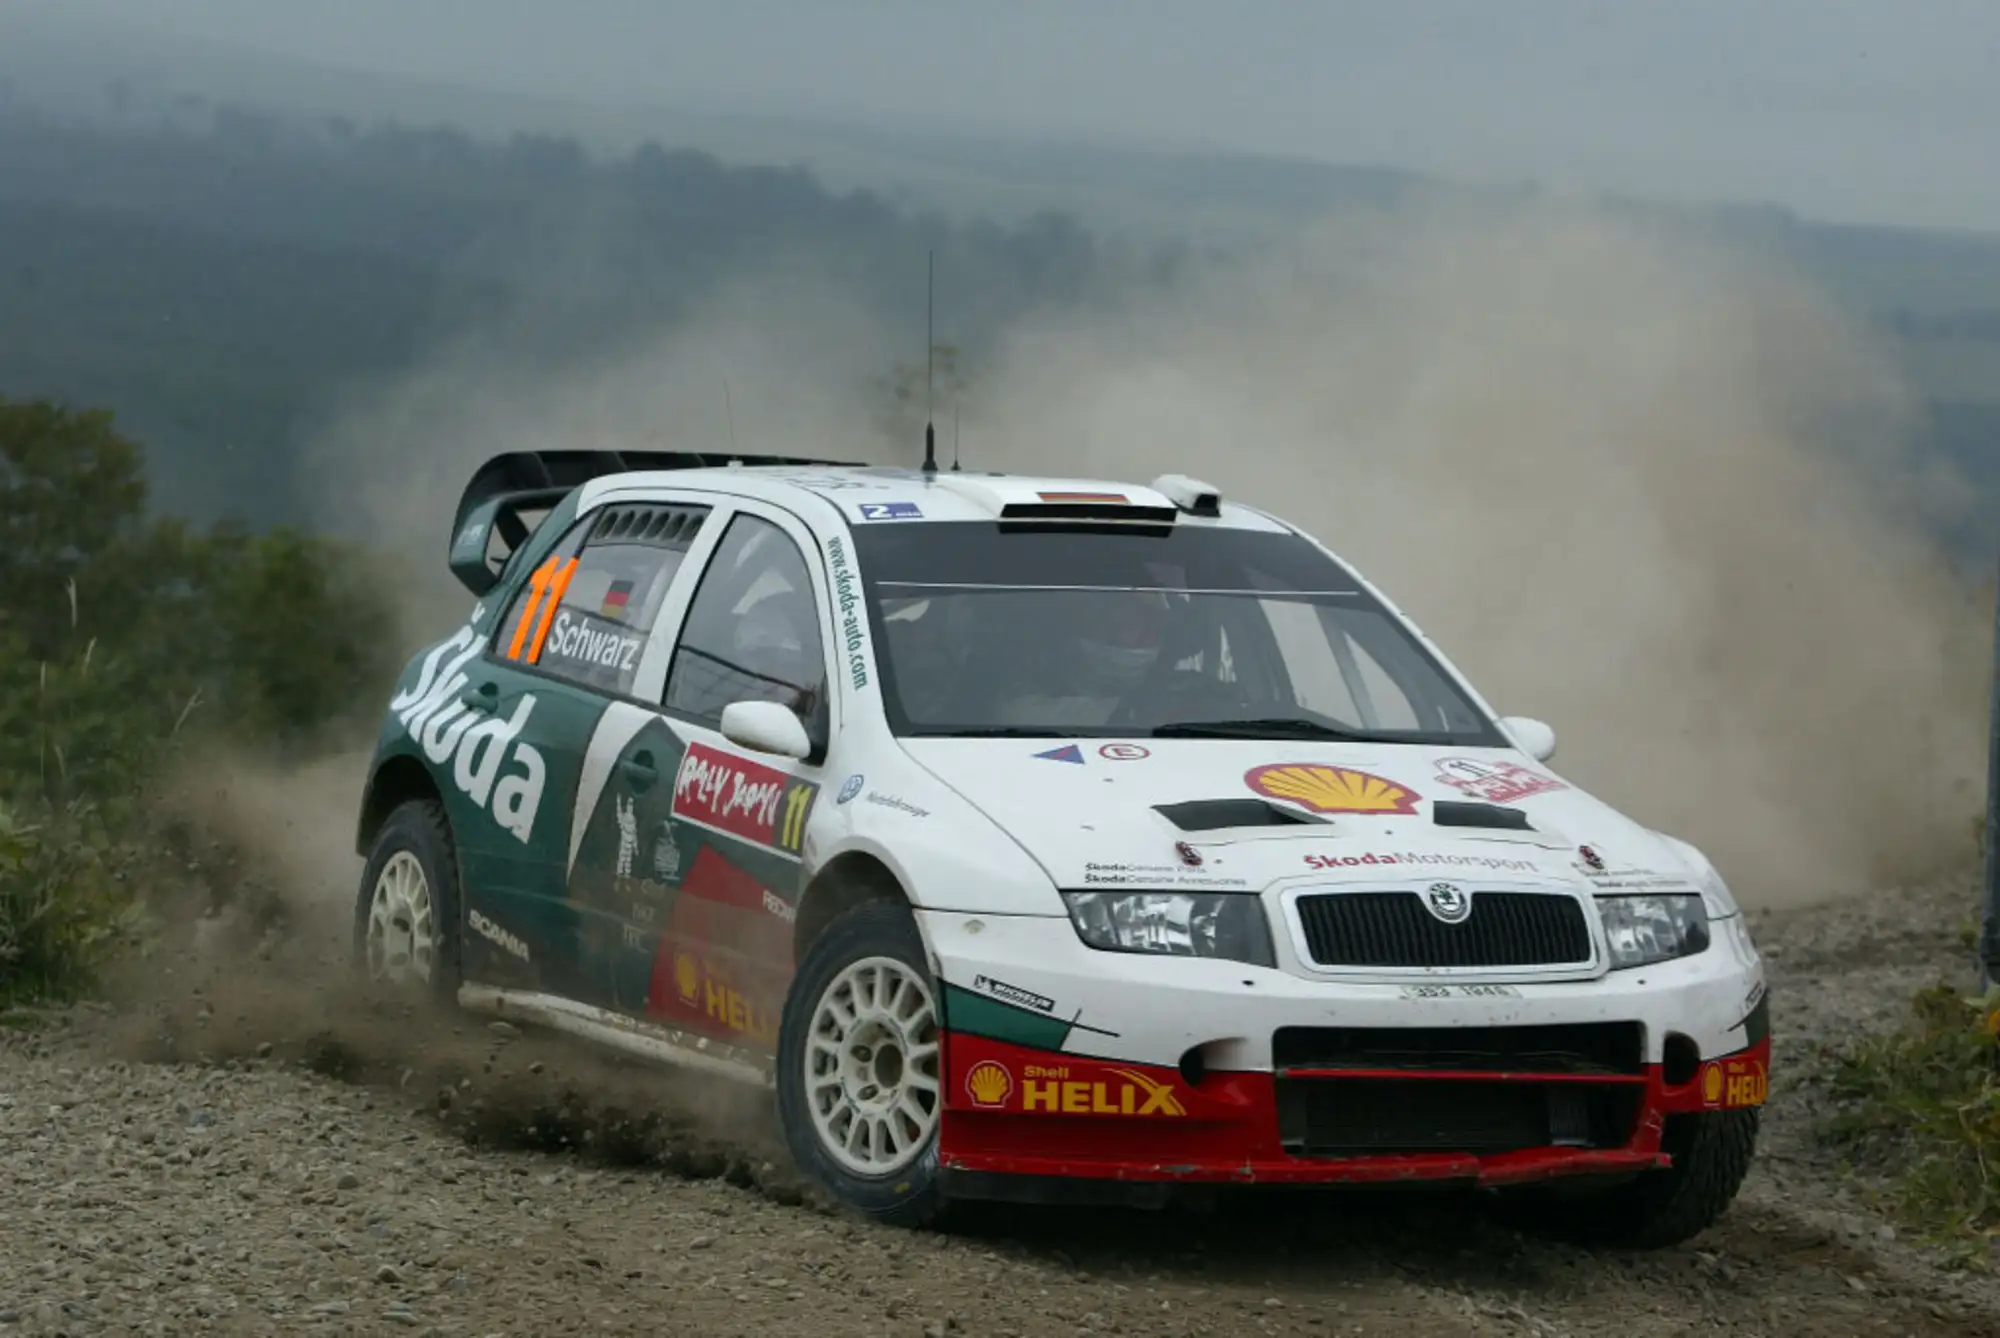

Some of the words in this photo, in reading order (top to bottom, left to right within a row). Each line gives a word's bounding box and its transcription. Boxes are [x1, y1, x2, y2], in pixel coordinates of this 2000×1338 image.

[507, 554, 580, 665] 11
[548, 612, 641, 671] Schwarz
[783, 783, 814, 850] 11
[468, 907, 530, 964] SCANIA
[1022, 1074, 1188, 1116] HELIX
[1024, 1065, 1070, 1079] Shell
